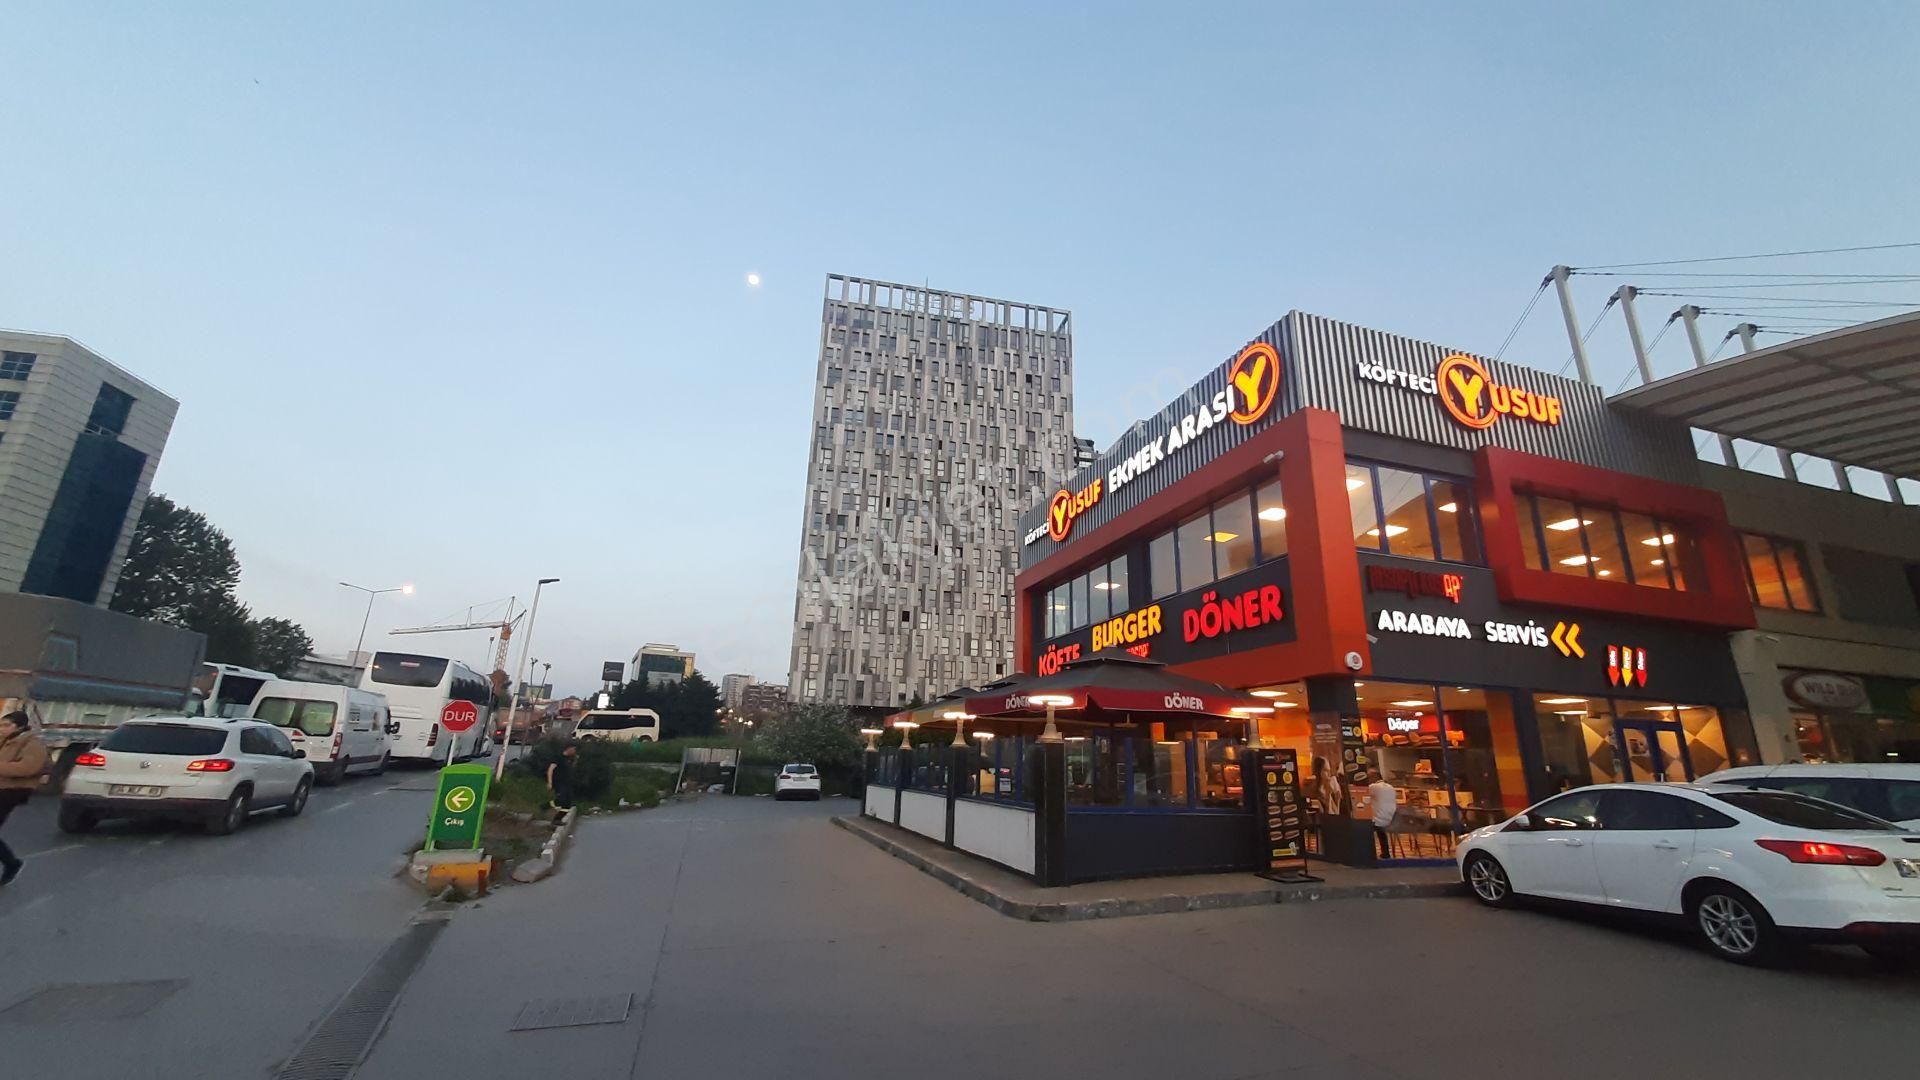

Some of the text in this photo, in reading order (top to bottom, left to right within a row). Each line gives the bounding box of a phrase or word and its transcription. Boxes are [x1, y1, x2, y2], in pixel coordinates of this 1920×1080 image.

[1446, 363, 1562, 427] YUSUF
[1053, 478, 1103, 536] YUSUF
[1109, 436, 1164, 493] EKMEK
[1167, 384, 1235, 455] ARASI
[1092, 604, 1162, 652] BURGER
[1183, 584, 1283, 643] DÖNER
[1377, 609, 1549, 648] ARABAYA SERVİS
[444, 711, 475, 722] DUR
[1164, 692, 1203, 711] DÖNER
